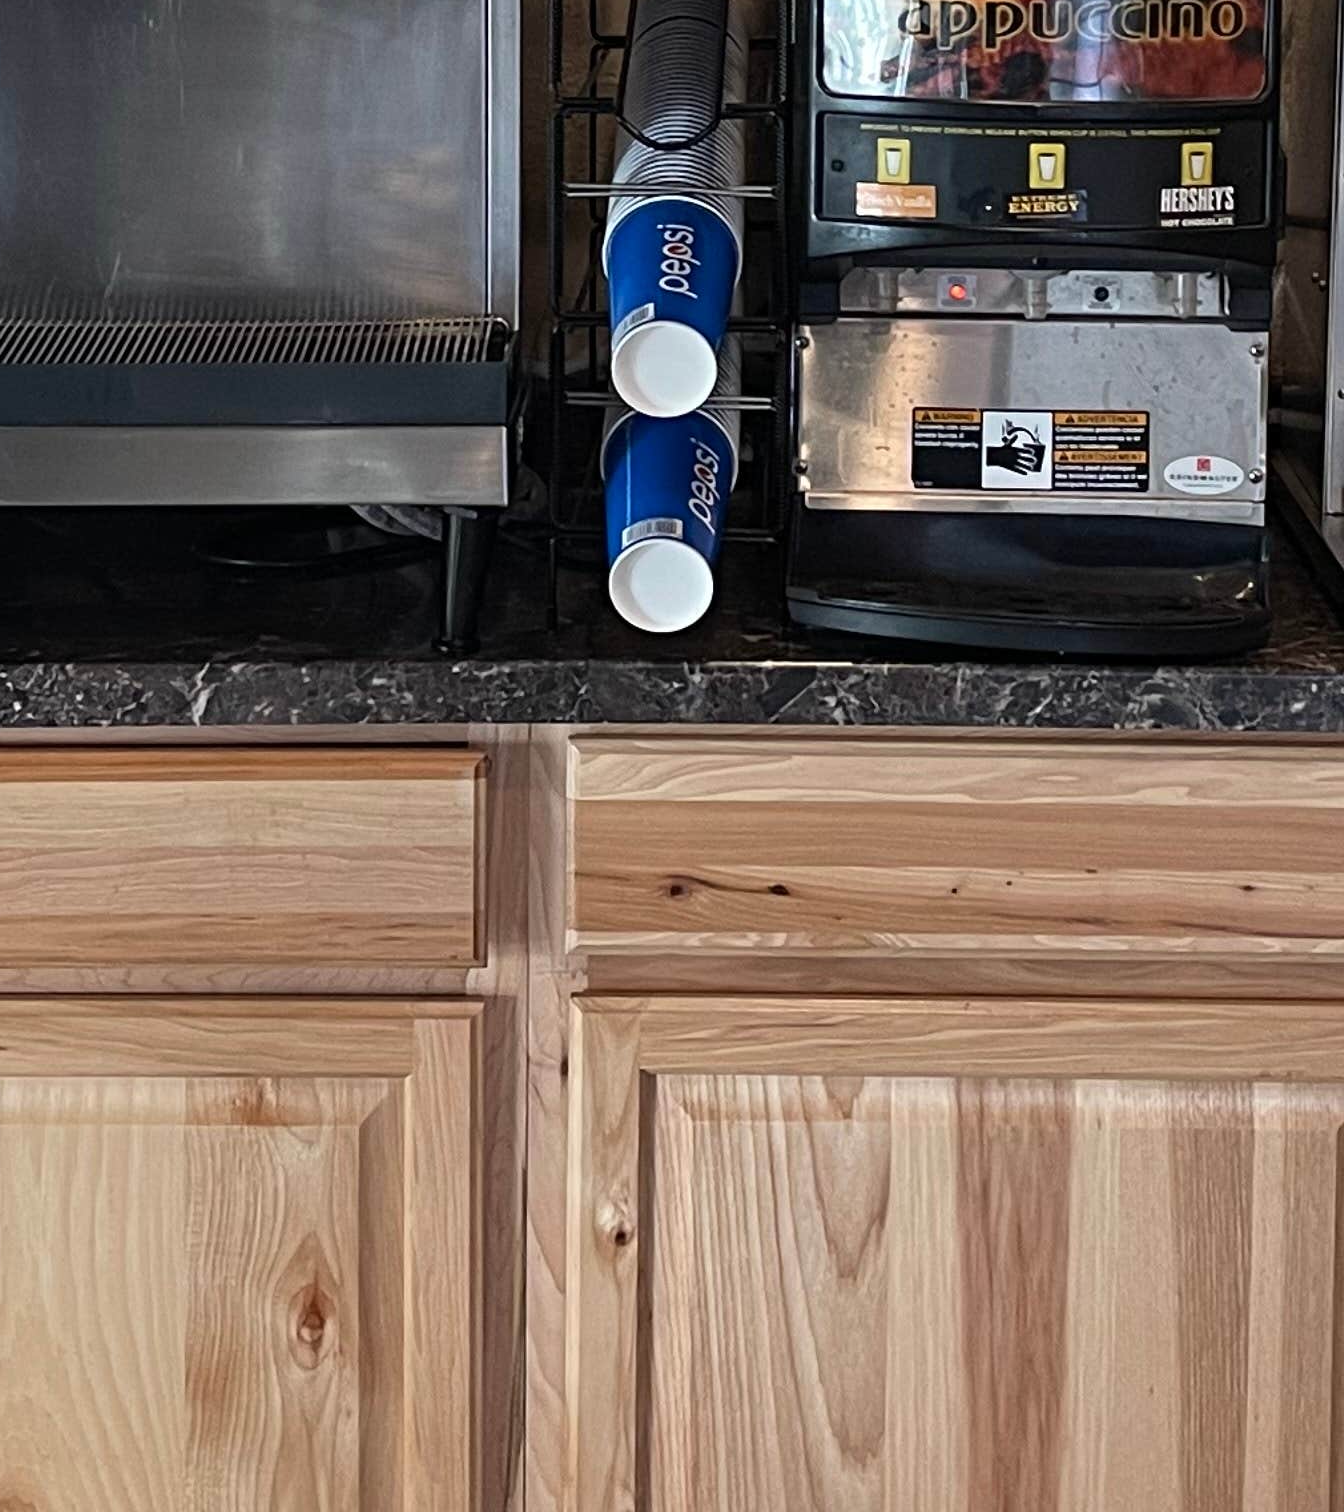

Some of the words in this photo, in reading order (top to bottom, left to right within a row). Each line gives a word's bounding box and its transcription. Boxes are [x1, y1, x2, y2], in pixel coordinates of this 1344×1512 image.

[1008, 201, 1081, 214] ENERGY
[1160, 185, 1235, 214] HERSHEY'S
[1161, 218, 1180, 227] HOT
[1181, 217, 1234, 227] CHOCOLATE
[657, 223, 701, 298] pepsi
[688, 439, 721, 534] pepsi
